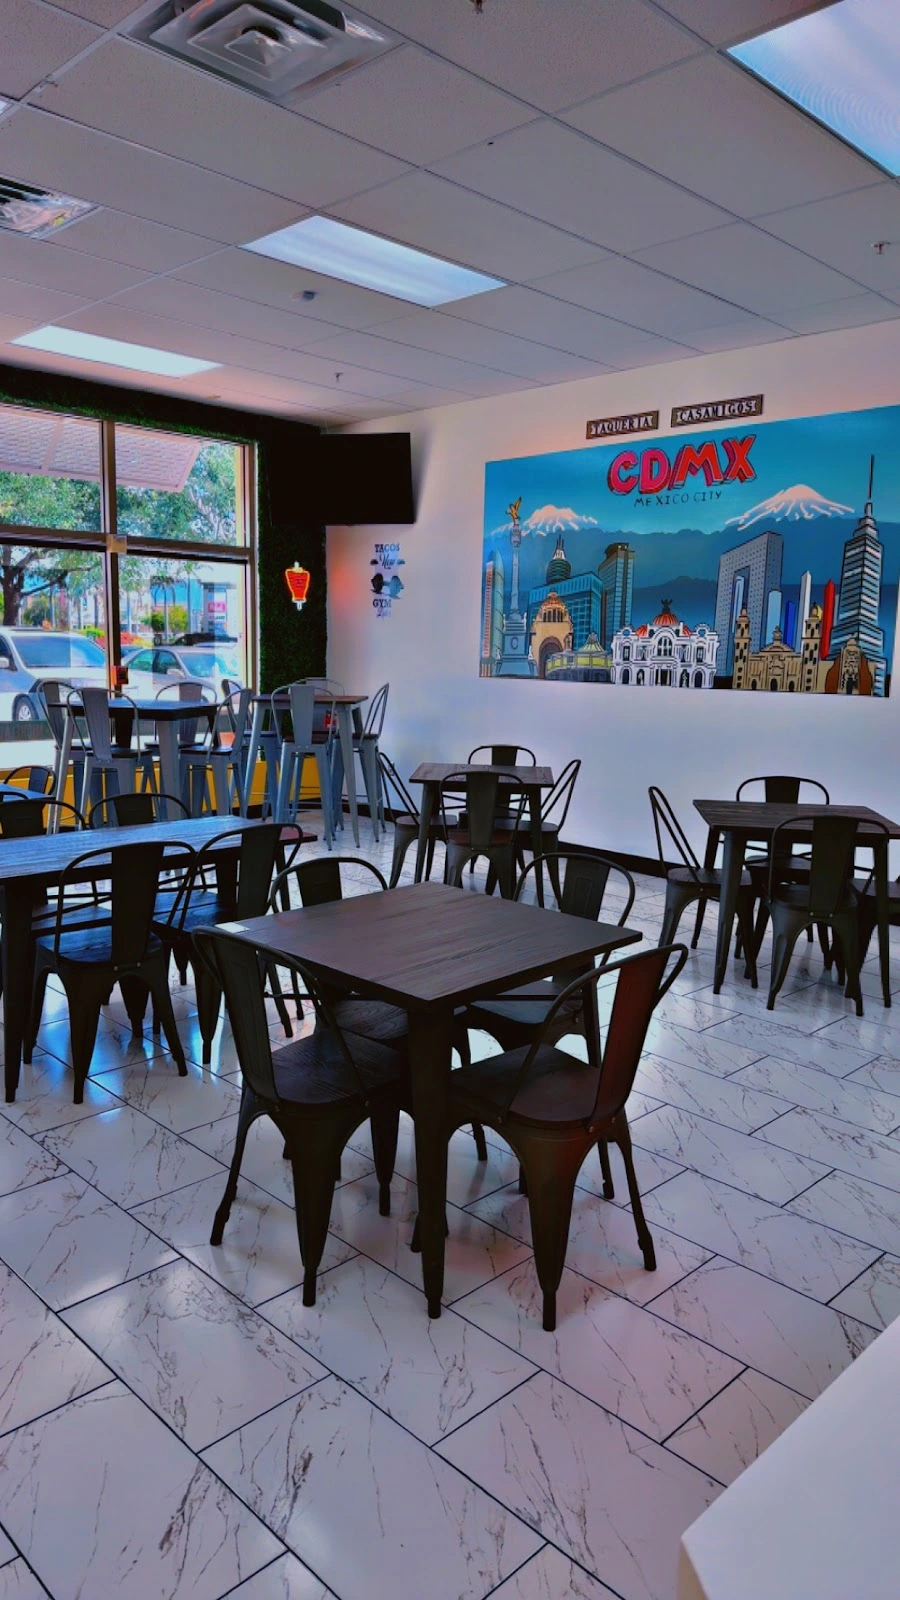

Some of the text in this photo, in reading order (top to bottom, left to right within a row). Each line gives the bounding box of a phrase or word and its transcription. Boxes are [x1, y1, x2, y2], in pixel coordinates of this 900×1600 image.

[593, 401, 754, 435] TAQUERIA CASAMIGOS
[607, 434, 757, 496] CDMX
[634, 491, 722, 507] MEXICO CITY
[375, 544, 400, 552] TACOS
[372, 599, 392, 608] GYM
